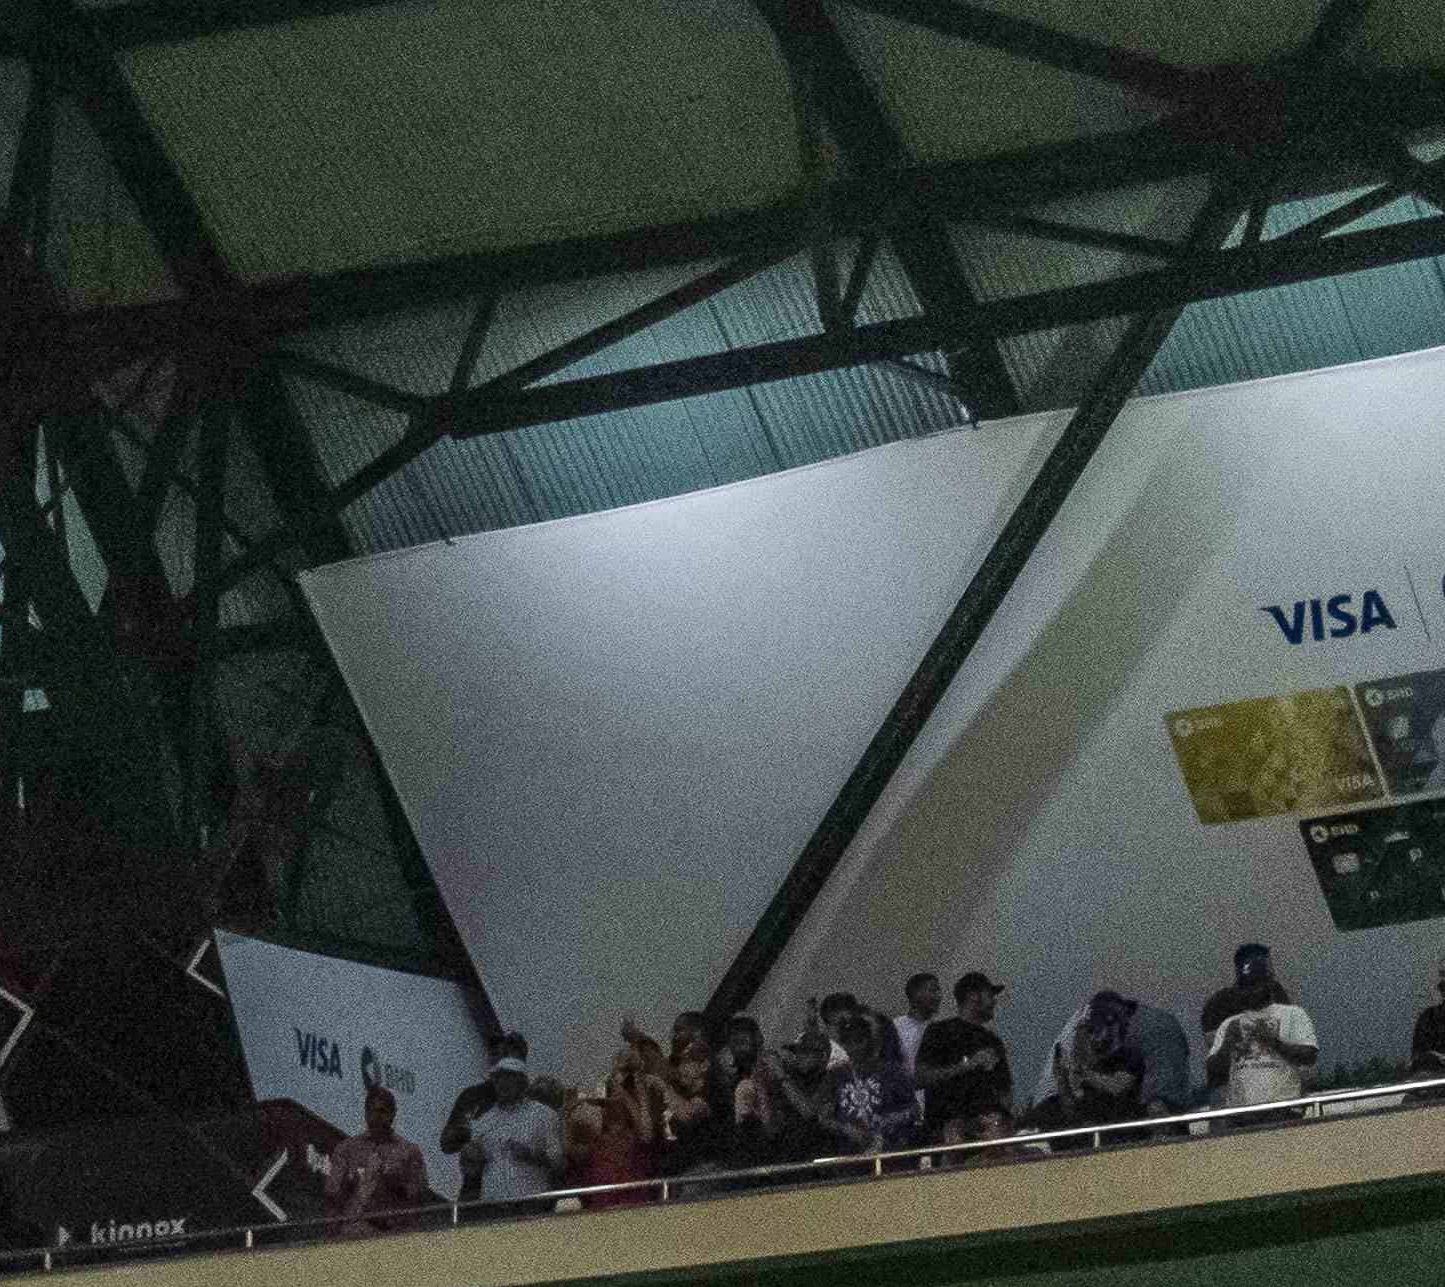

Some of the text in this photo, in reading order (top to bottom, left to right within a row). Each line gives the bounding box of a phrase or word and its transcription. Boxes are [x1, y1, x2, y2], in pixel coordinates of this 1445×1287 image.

[1261, 590, 1397, 645] VISA
[1335, 775, 1376, 794] VISA
[294, 1026, 344, 1080] VISA
[90, 1216, 186, 1246] kinnox
